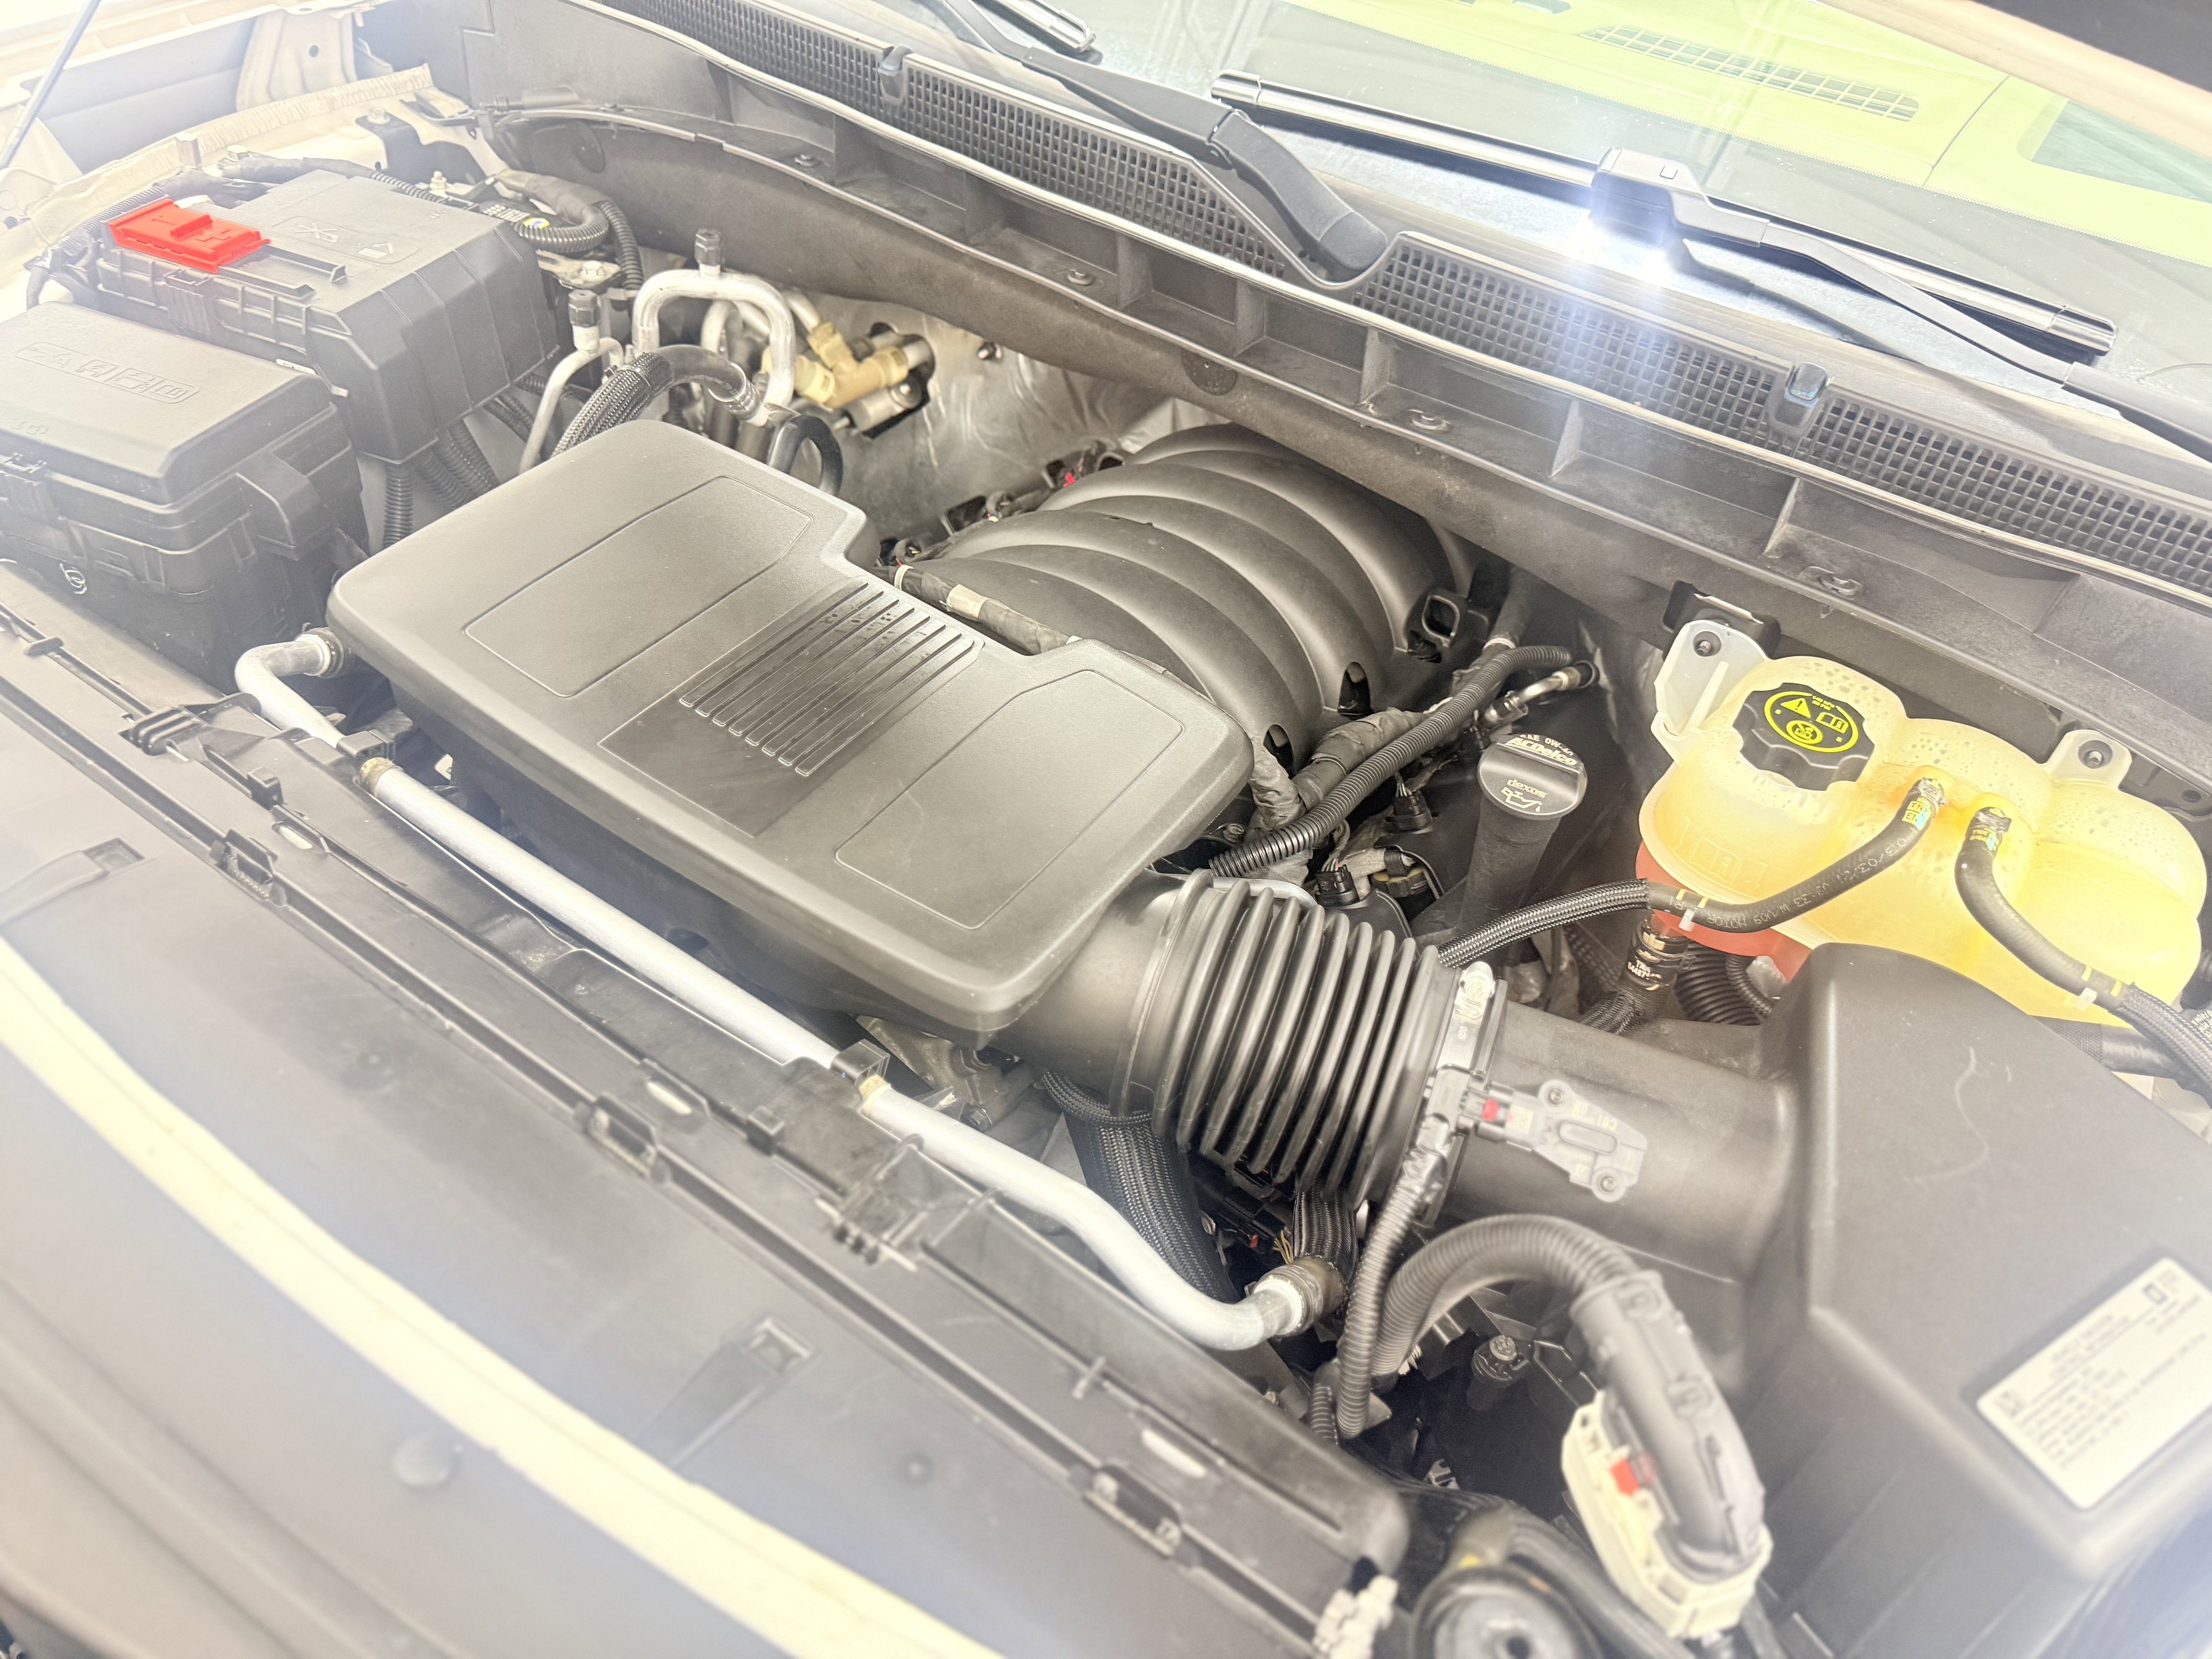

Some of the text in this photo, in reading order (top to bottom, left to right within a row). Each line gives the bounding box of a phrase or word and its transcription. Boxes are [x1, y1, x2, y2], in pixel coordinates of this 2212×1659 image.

[1504, 737, 1577, 766] ACDelco
[1506, 779, 1548, 799] dexos
[1706, 912, 1748, 929] MOTOR
